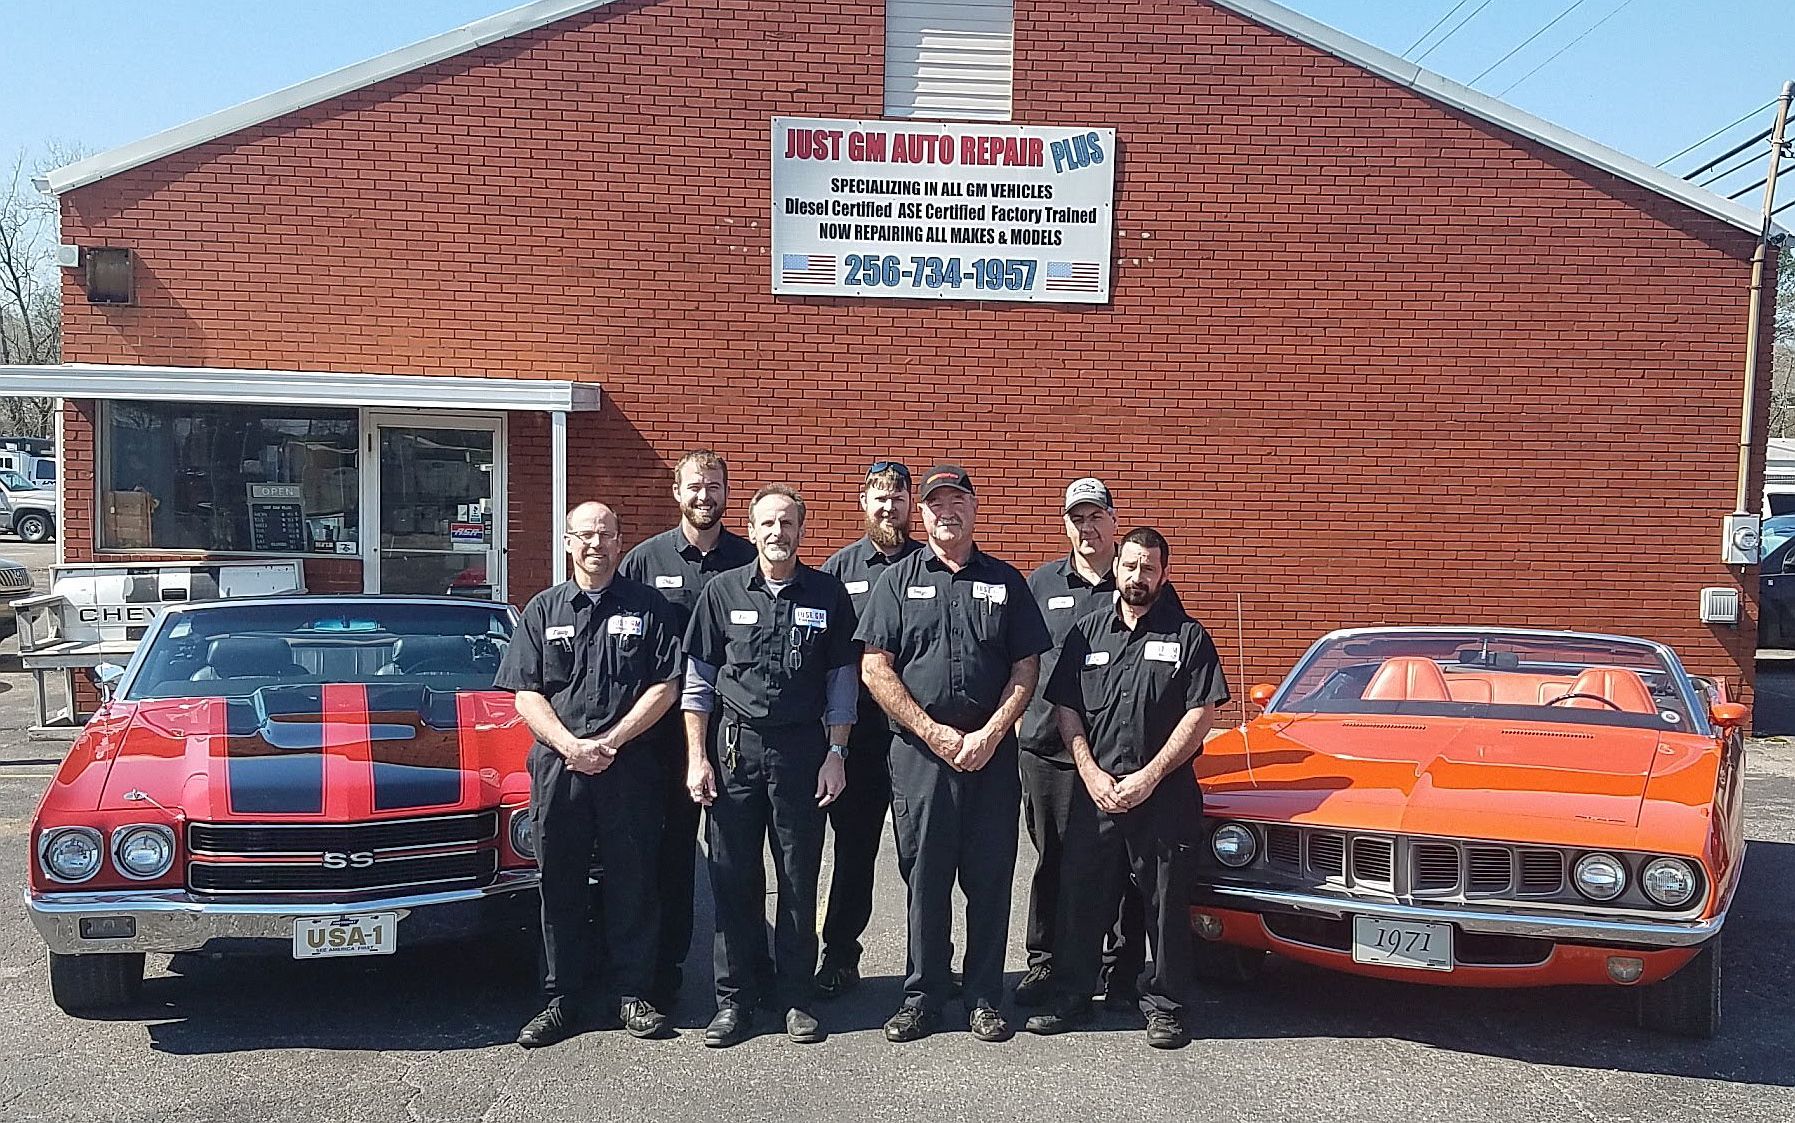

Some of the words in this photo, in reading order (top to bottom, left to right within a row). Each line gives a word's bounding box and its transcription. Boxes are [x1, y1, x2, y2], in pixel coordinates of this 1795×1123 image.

[785, 128, 844, 161] JUST
[848, 131, 887, 163] GM
[891, 133, 955, 165] AUTO
[960, 136, 1044, 167] REPAIR
[1050, 131, 1105, 174] PLUS
[831, 177, 921, 196] SPECIALIZING
[924, 181, 938, 196] IN
[941, 182, 963, 197] ALL
[966, 183, 988, 198] GM
[991, 183, 1053, 199] VEHICLES
[785, 198, 829, 216] Diesel
[832, 199, 892, 218] Certified
[898, 202, 923, 220] ASE
[925, 203, 986, 221] Certified
[991, 205, 1043, 225] Factory
[1045, 207, 1097, 224] Trained
[819, 223, 851, 240] NOW
[854, 224, 923, 242] REPAIRING
[926, 226, 948, 244] ALL
[950, 227, 995, 245] MAKES
[998, 230, 1008, 245] &
[1010, 229, 1063, 246] MODELS
[844, 253, 1038, 291] 256-734-1957
[261, 487, 294, 496] OPEN
[323, 851, 374, 868] SS
[307, 925, 382, 948] USA-1
[1374, 928, 1431, 958] 1971
